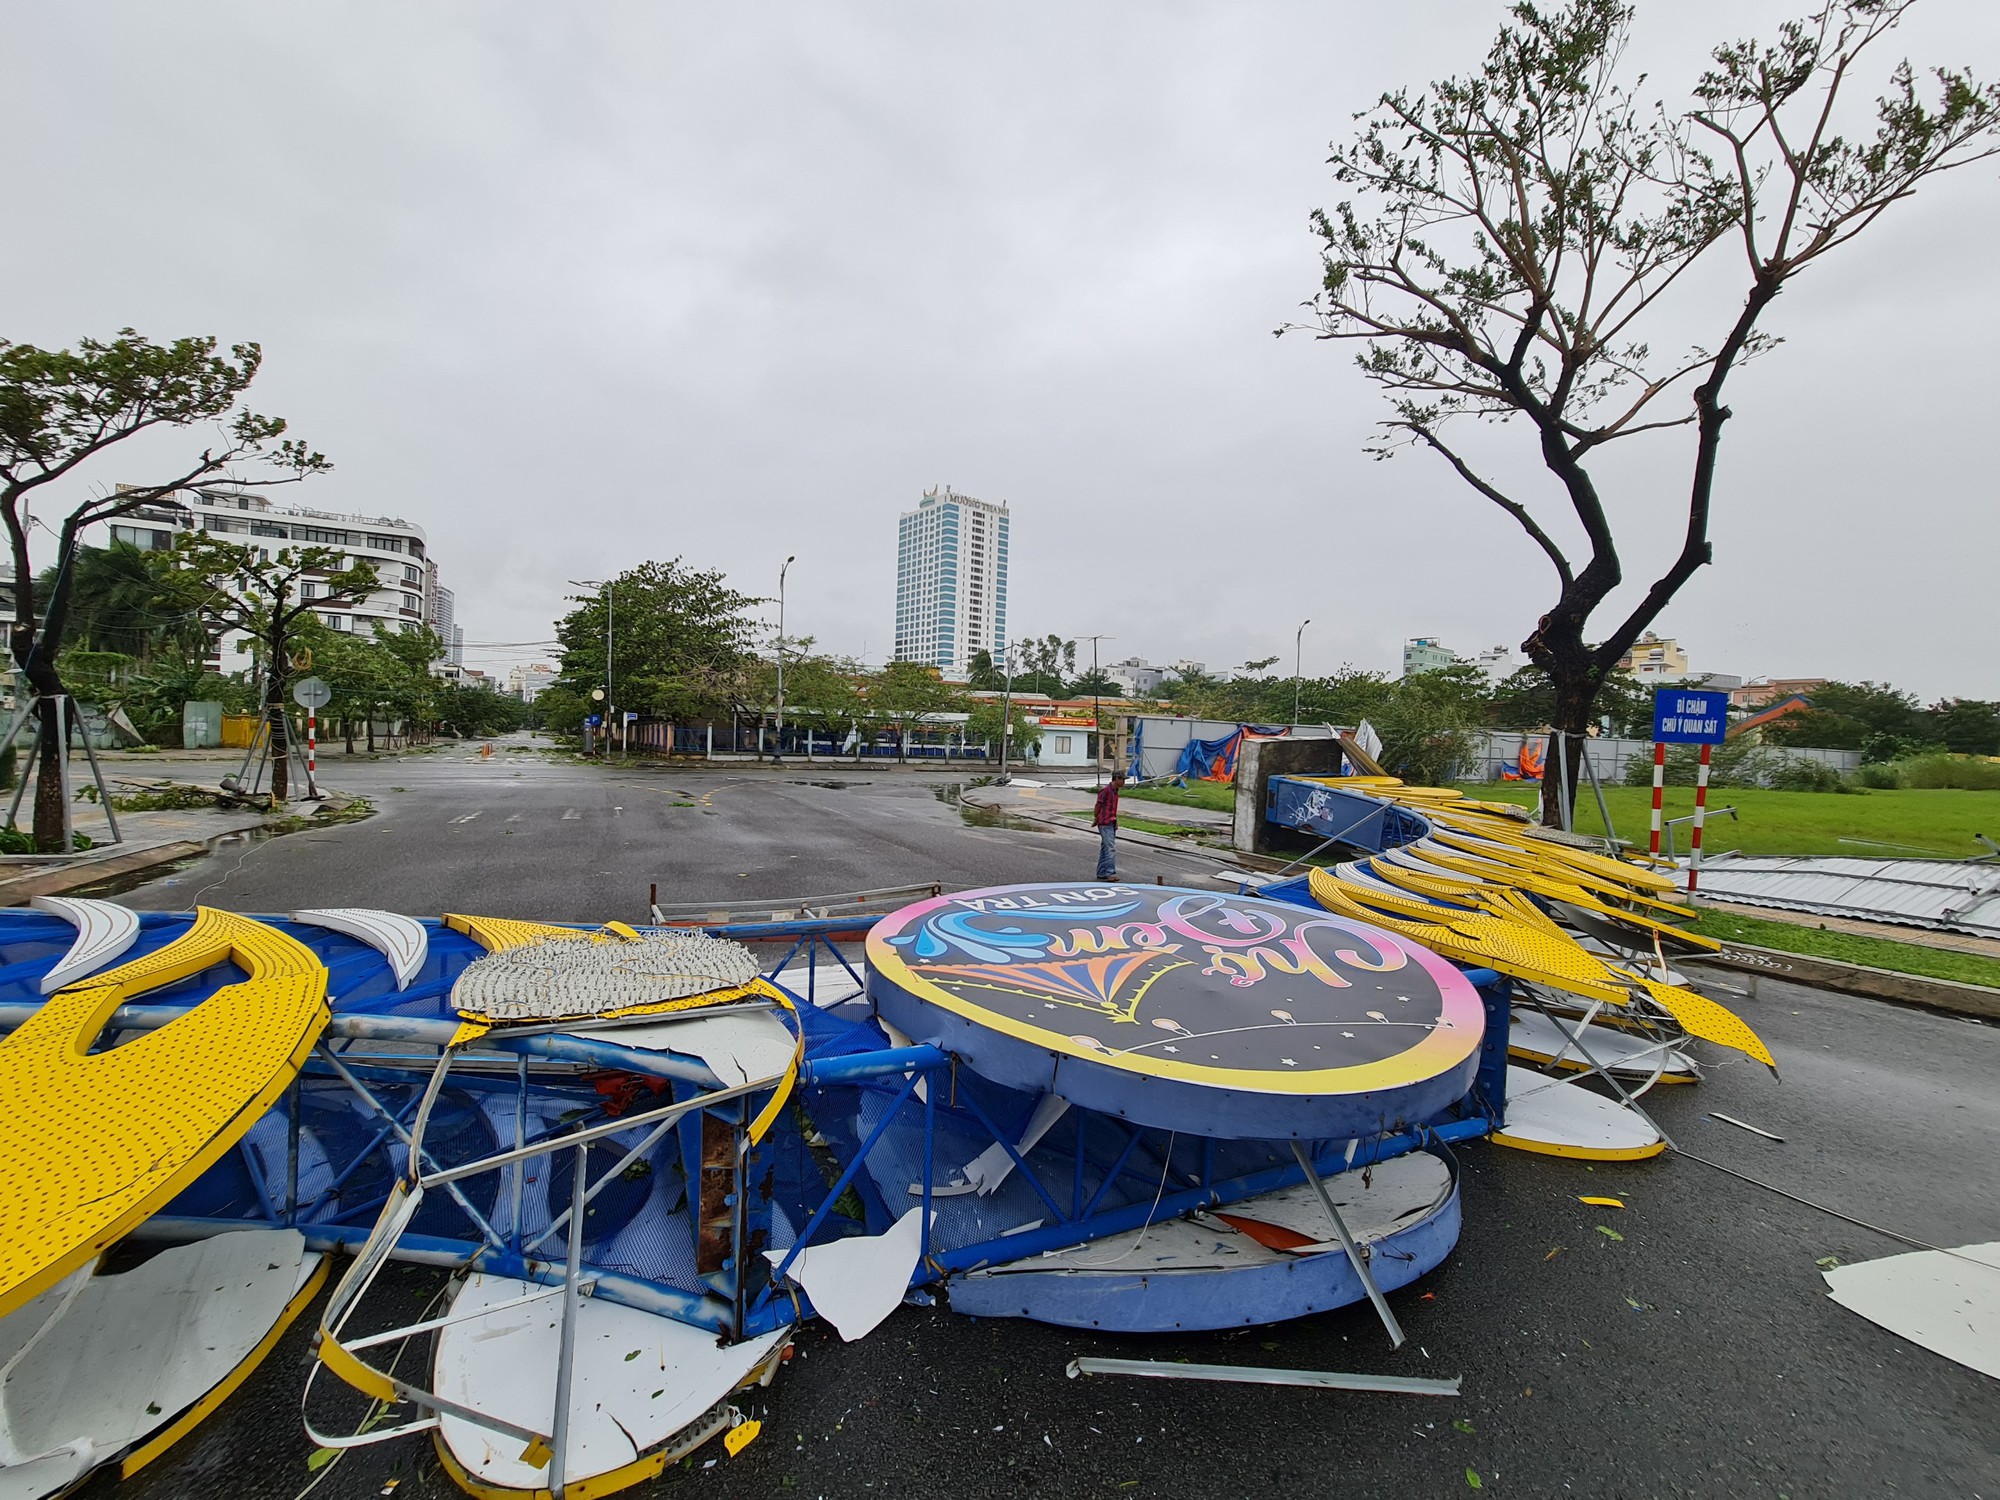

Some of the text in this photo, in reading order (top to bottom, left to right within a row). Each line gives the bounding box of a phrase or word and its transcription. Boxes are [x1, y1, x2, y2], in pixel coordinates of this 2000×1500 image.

[981, 502, 1009, 516] THANH
[1677, 716, 1683, 733] Ý
[1683, 718, 1703, 734] QUAN
[1703, 717, 1718, 734] SÁT
[954, 885, 1139, 914] SƠN TRÀ
[1202, 920, 1408, 988] Chợ
